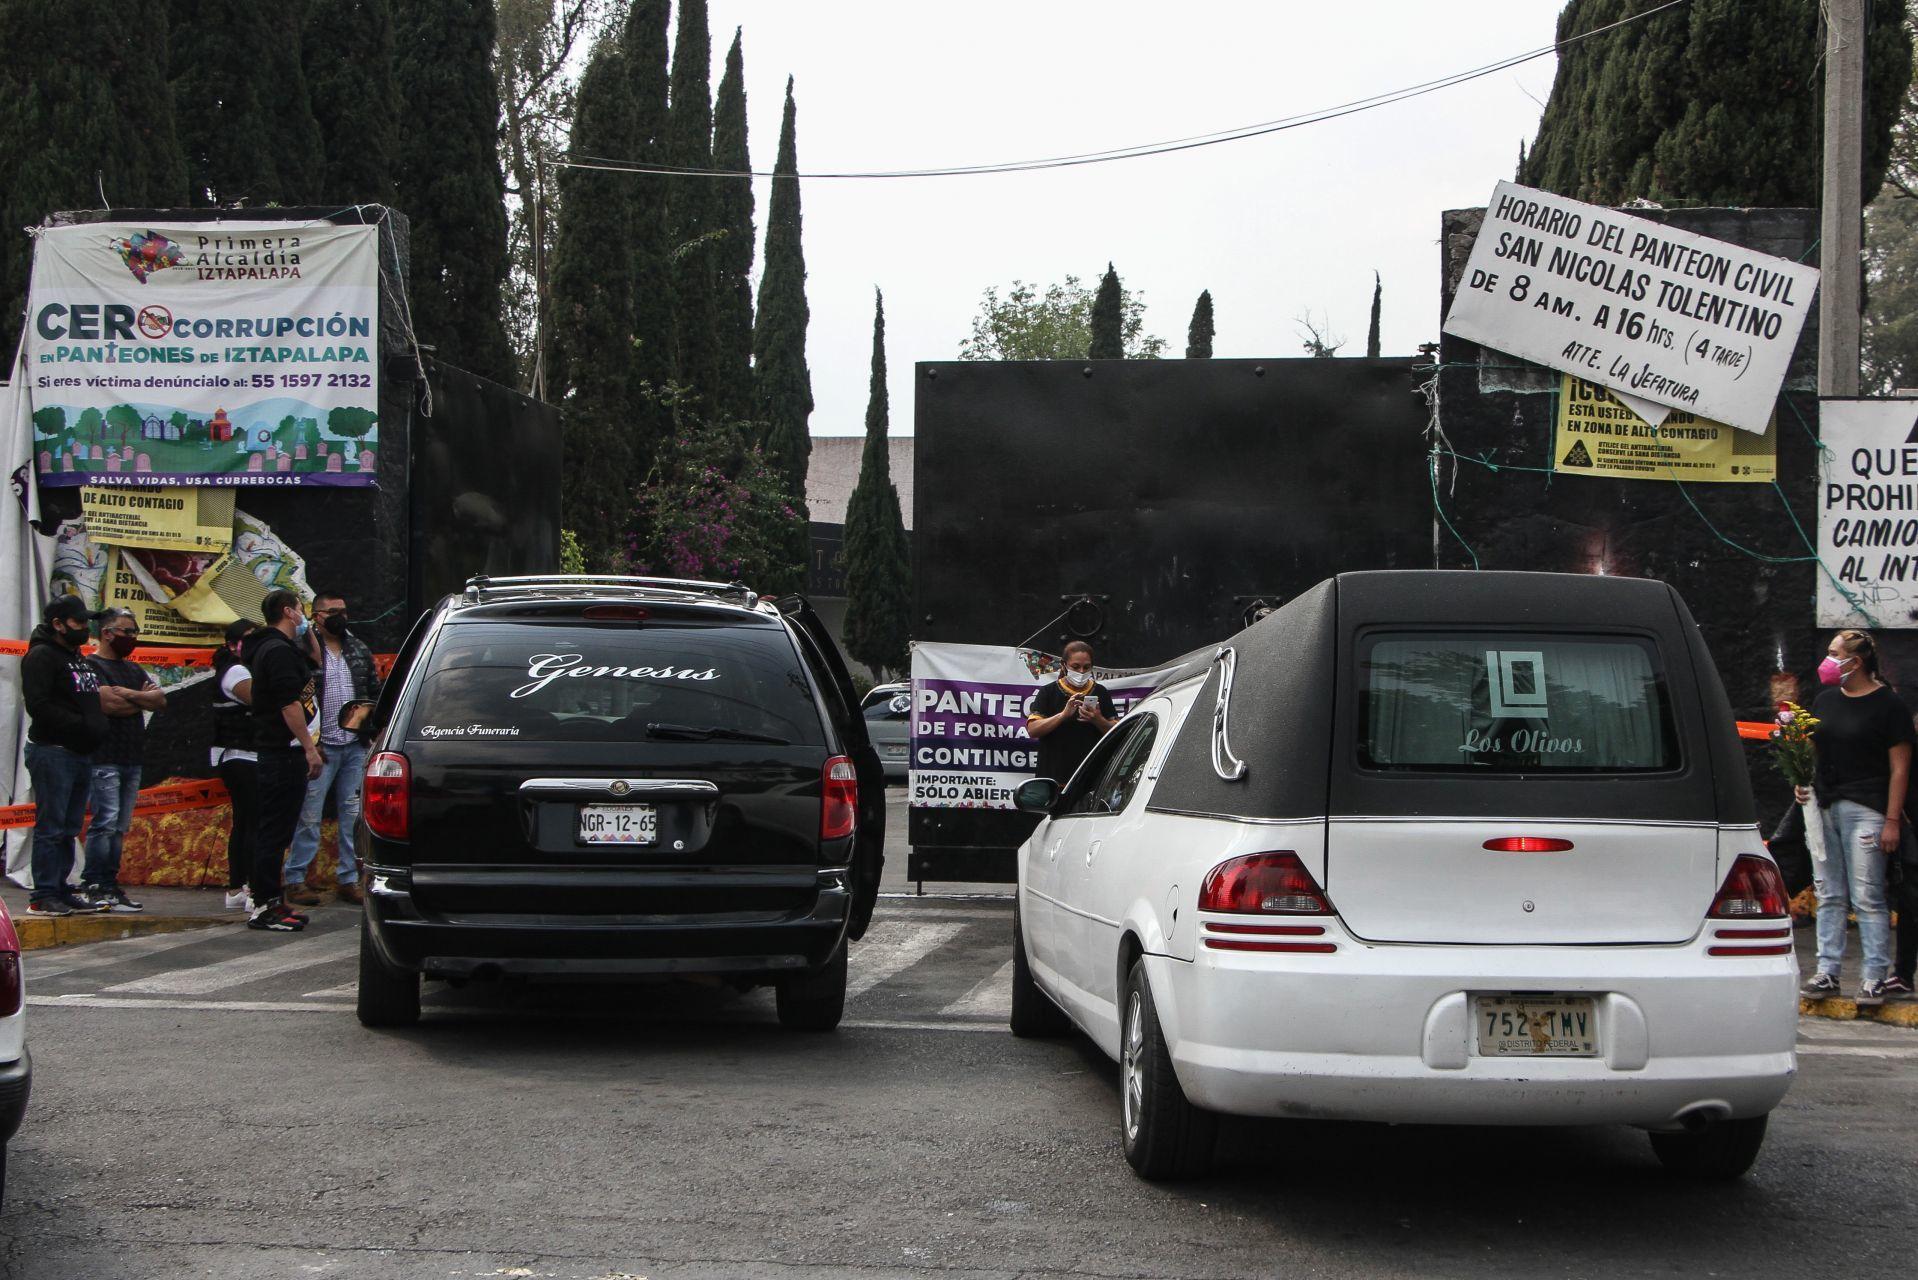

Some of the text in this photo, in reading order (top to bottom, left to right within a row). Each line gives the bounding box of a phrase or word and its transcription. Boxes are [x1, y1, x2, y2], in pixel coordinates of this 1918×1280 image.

[198, 236, 301, 250] Primera
[1494, 194, 1796, 307] HORARIO DEL PANTEON CIVIL
[196, 250, 301, 266] Alcaldía
[198, 267, 301, 280] IZTAPALAPA
[1494, 232, 1783, 341] SAN NICOLAS TOLENTINO
[1469, 269, 1499, 294] DE
[1509, 274, 1531, 303] 8
[1593, 304, 1611, 330] A
[1615, 308, 1644, 341] 16
[1645, 318, 1675, 352] hrs.
[173, 311, 370, 338] CORRUPCIÓN
[40, 353, 55, 363] EN
[200, 353, 219, 363] DE
[225, 347, 370, 363] IZTAPALAPA
[38, 374, 371, 388] Si eres víctima denúncialo al: 55 1597 2132
[1562, 340, 1602, 370] ATTE.
[1609, 354, 1629, 382] LA
[1631, 363, 1700, 406] JEFATURA
[1568, 403, 1595, 417] ESTÁ
[1598, 406, 1633, 420] USTED
[1567, 420, 1719, 440] EN ZONA DE ALTO CONTAGIO
[90, 476, 302, 486] SALVA VIDAS, USA CUBREBOCAS
[83, 492, 184, 510] DE ALTO CONTAGIO
[1826, 483, 1918, 511] PROHI
[1832, 517, 1918, 548] CAMIO
[116, 572, 138, 586] EST
[1838, 556, 1868, 584] AL
[114, 588, 128, 600] EN
[509, 652, 721, 699] Genesis
[420, 723, 520, 740] Agencia Funeraria
[918, 721, 1030, 739] DE FORMA
[1457, 728, 1586, 753] Los Olivos
[917, 747, 1038, 769] CONTINGE
[917, 774, 997, 787] IMPORTANTE:
[915, 785, 960, 800] SÓLO
[580, 813, 656, 832] NGR-12-65
[1508, 1040, 1543, 1048] DISTRITO
[1544, 1040, 1579, 1048] FEDERAL
